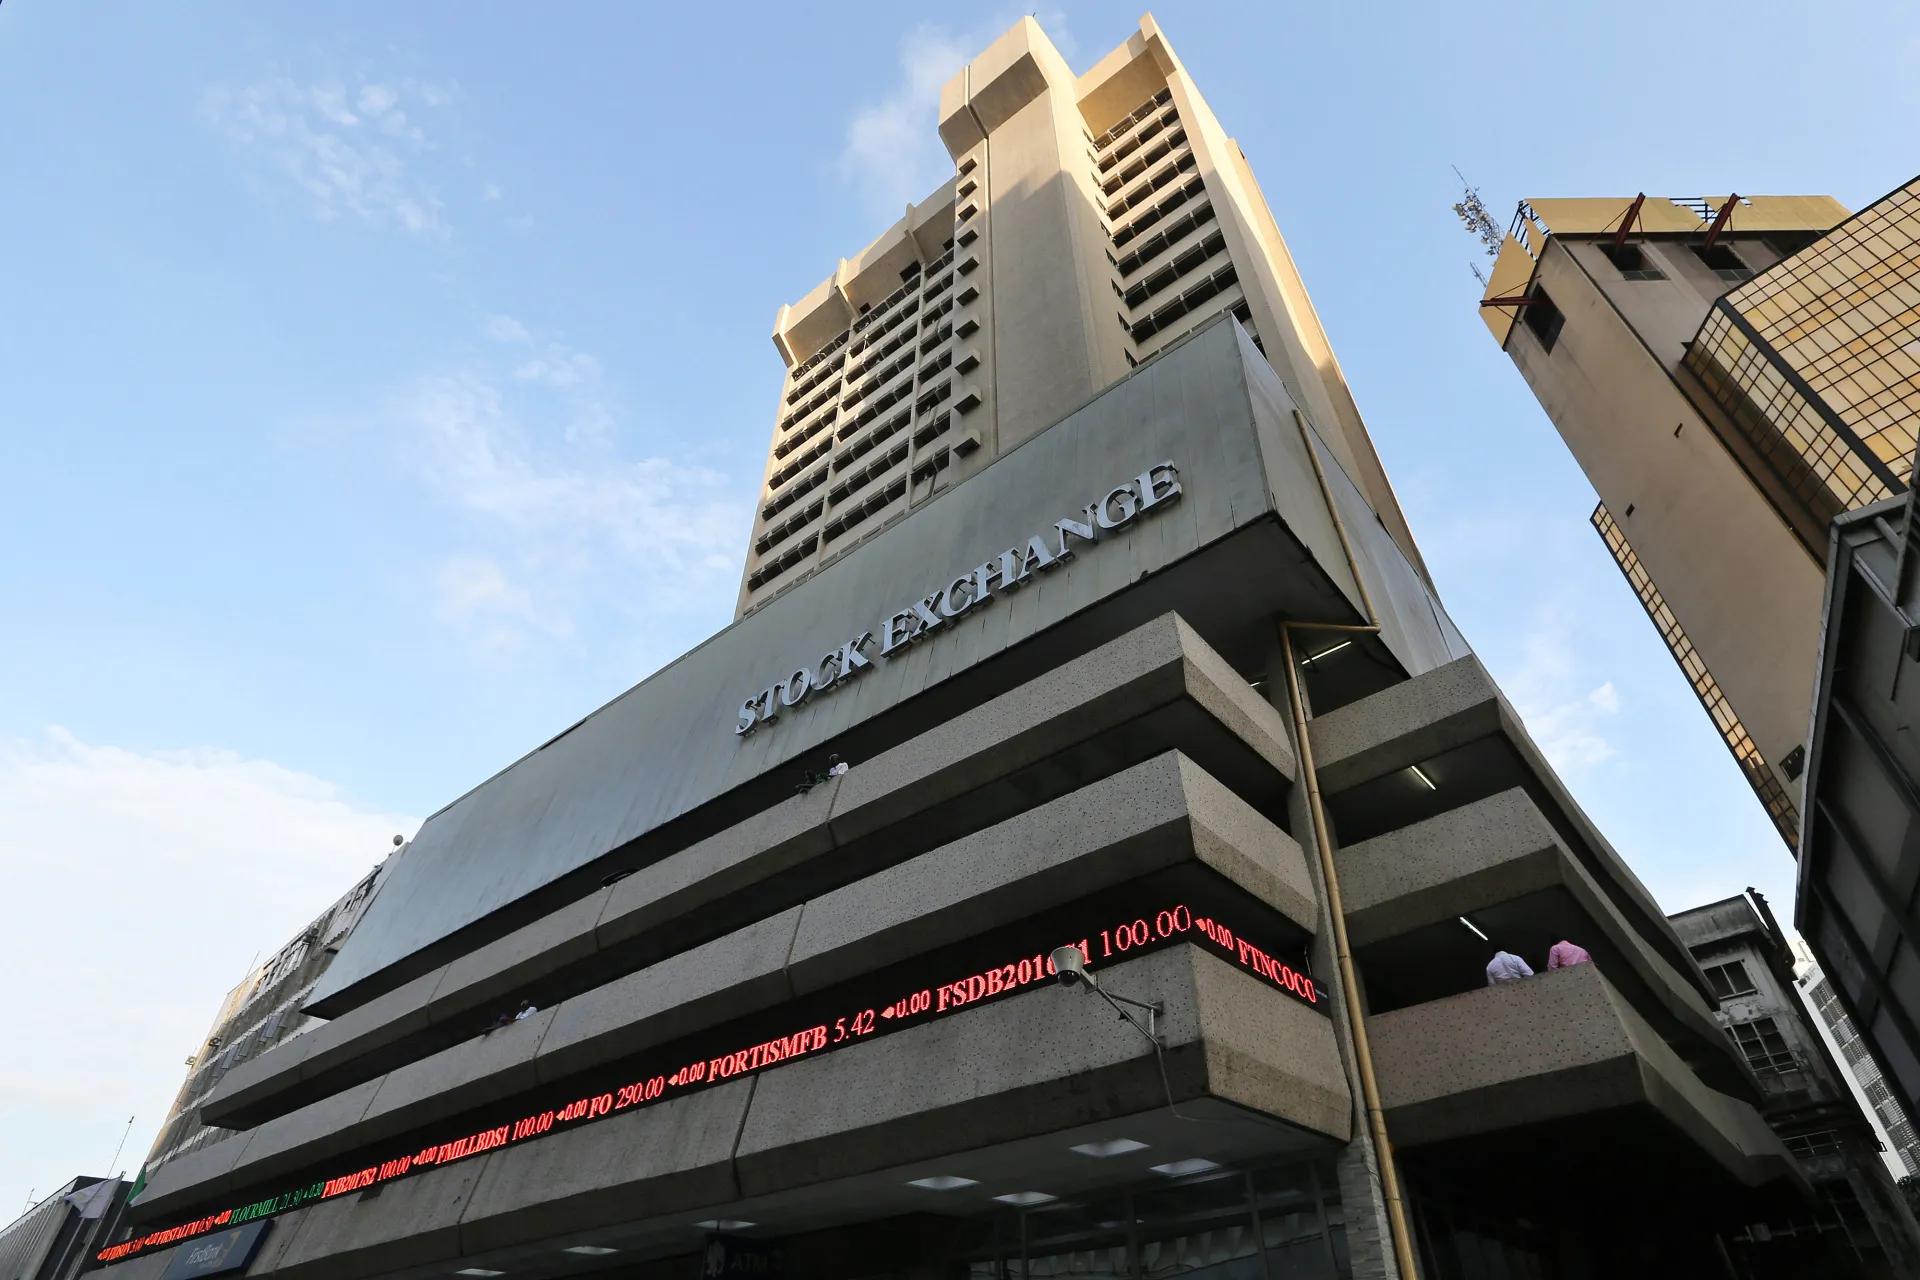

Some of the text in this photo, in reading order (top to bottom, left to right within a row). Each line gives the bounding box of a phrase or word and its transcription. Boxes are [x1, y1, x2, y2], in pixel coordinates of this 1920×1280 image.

[735, 459, 1183, 736] STOCK EXCHANGE
[377, 1155, 411, 1181] 100.00
[417, 1146, 437, 1165] 0.00
[511, 1111, 554, 1141] 100.00
[564, 1099, 587, 1121] 0.00
[587, 1093, 614, 1120] FO
[615, 1075, 665, 1109] 290.00
[678, 1061, 705, 1086] 0.00
[706, 1025, 828, 1083] FORTISMFB
[833, 1008, 876, 1043] 5.42
[896, 989, 931, 1019] 0.00
[1100, 904, 1192, 957] 100.00
[1206, 918, 1317, 1004] 0.00 FTNCOCO
